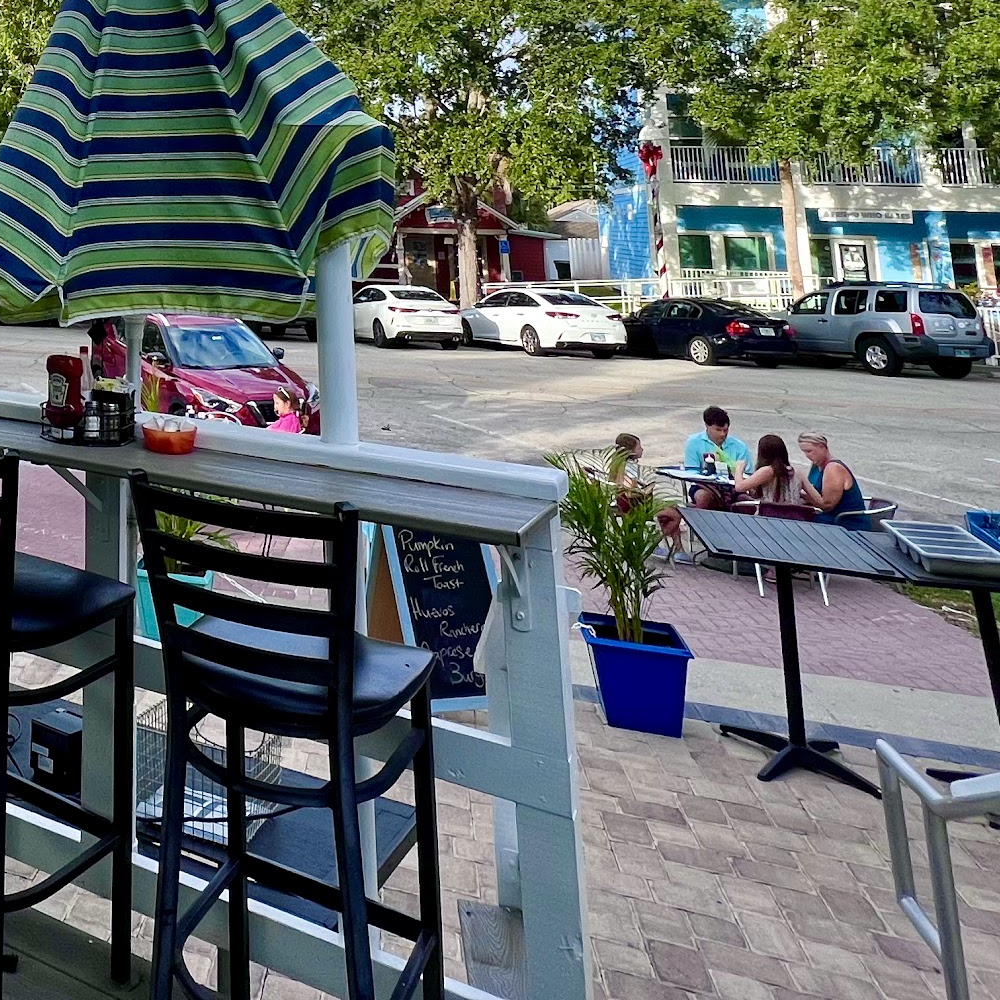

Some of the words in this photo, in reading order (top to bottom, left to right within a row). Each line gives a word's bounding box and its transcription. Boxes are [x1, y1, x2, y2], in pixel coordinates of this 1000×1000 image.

[398, 529, 454, 557] Pumpkin
[432, 555, 465, 573] French
[423, 575, 464, 590] Toast
[410, 596, 455, 620] Huevos
[421, 641, 474, 670] aprese
[449, 662, 485, 688] Burg
